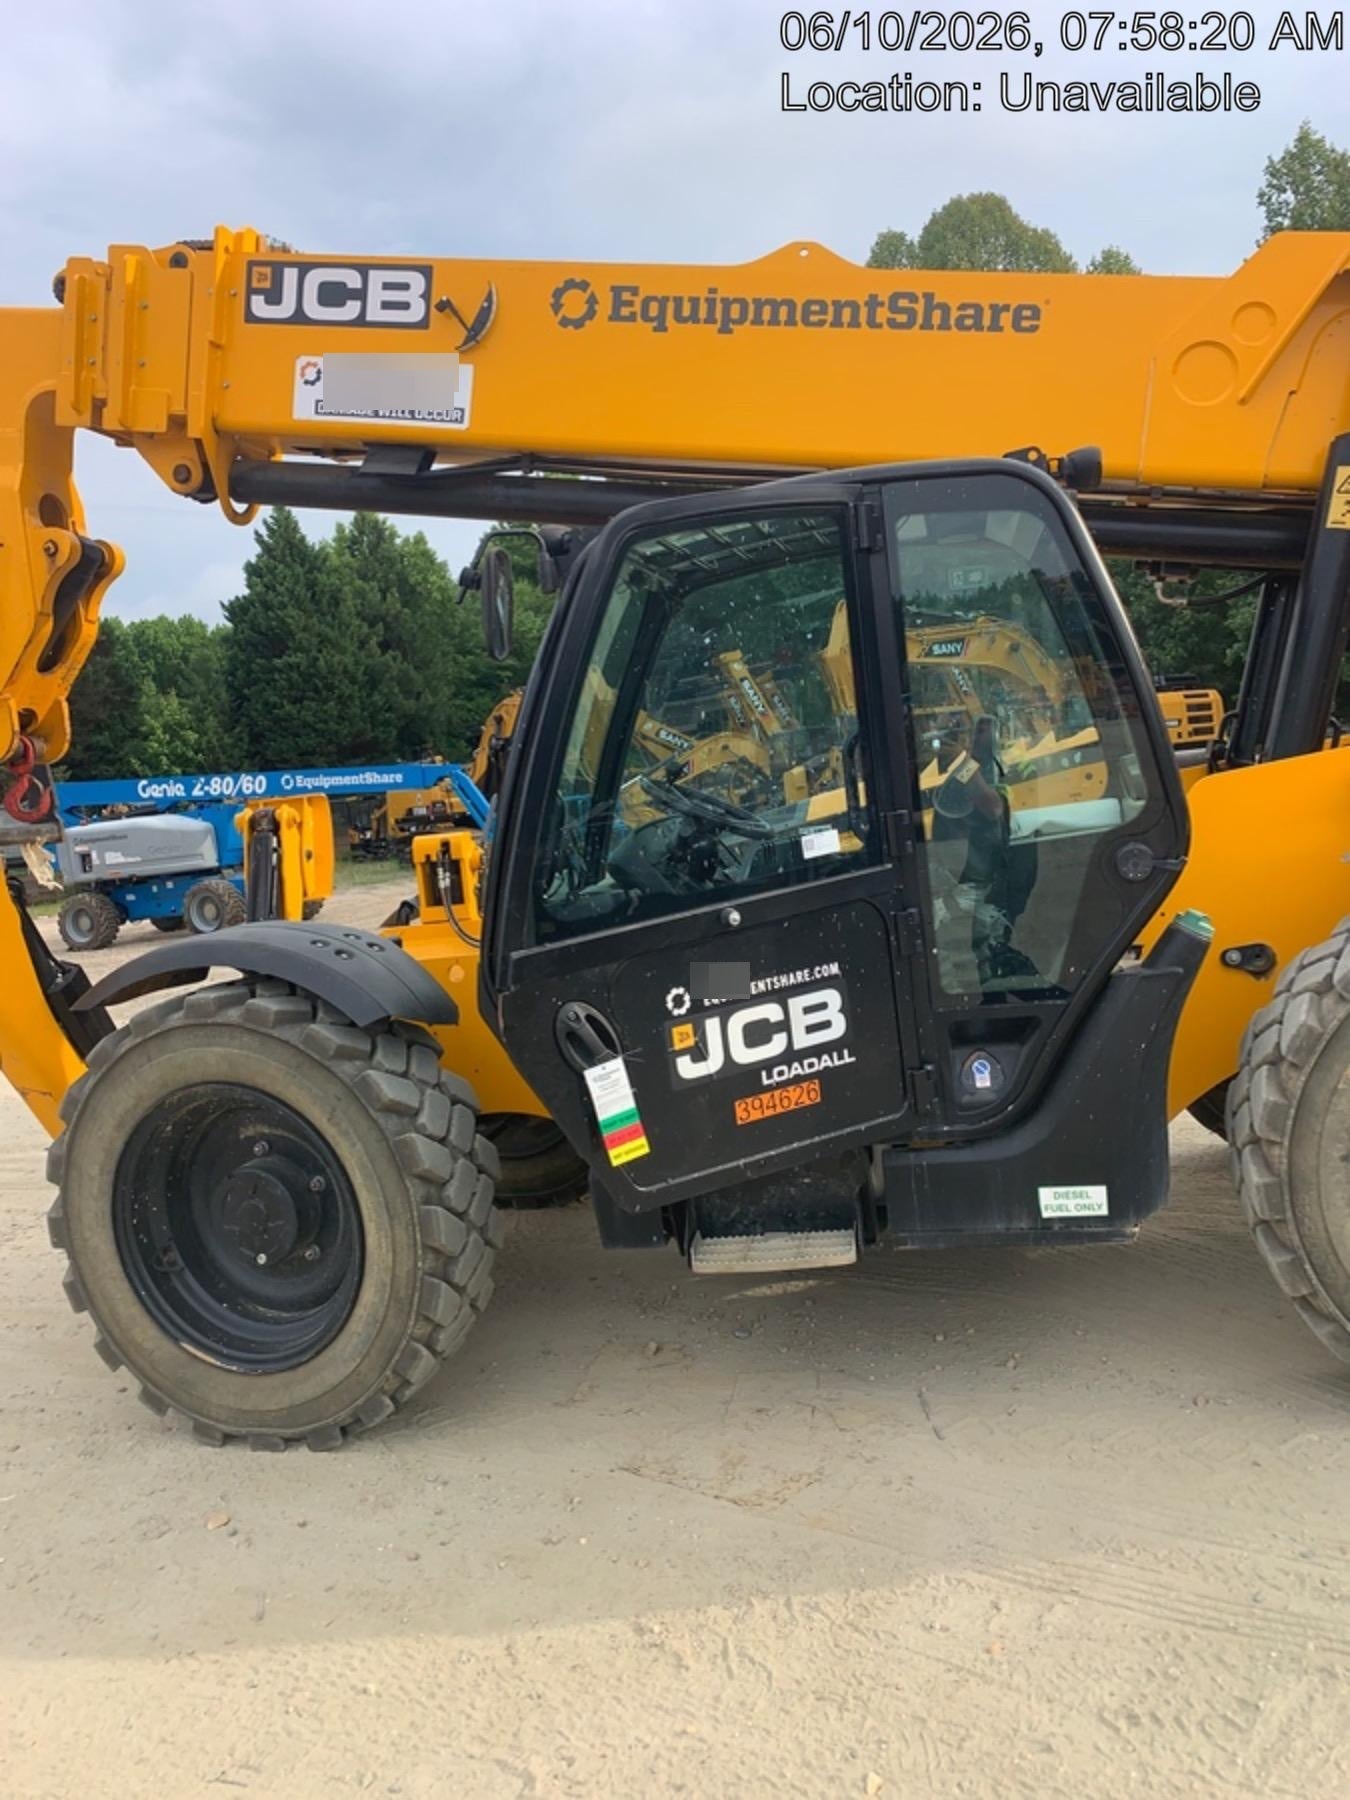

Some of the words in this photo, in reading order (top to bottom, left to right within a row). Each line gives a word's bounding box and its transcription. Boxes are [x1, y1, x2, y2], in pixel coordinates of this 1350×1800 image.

[250, 266, 427, 323] JCB
[607, 285, 1041, 335] EquipmentShare
[295, 771, 404, 788] EquipmentShare
[675, 987, 848, 1080] JCB
[761, 1048, 856, 1086] LOADALL
[737, 1080, 820, 1124] 394626
[1043, 1203, 1071, 1213] FUEL
[1073, 1201, 1104, 1213] ONLY
[1052, 1190, 1092, 1201] DIESEL
